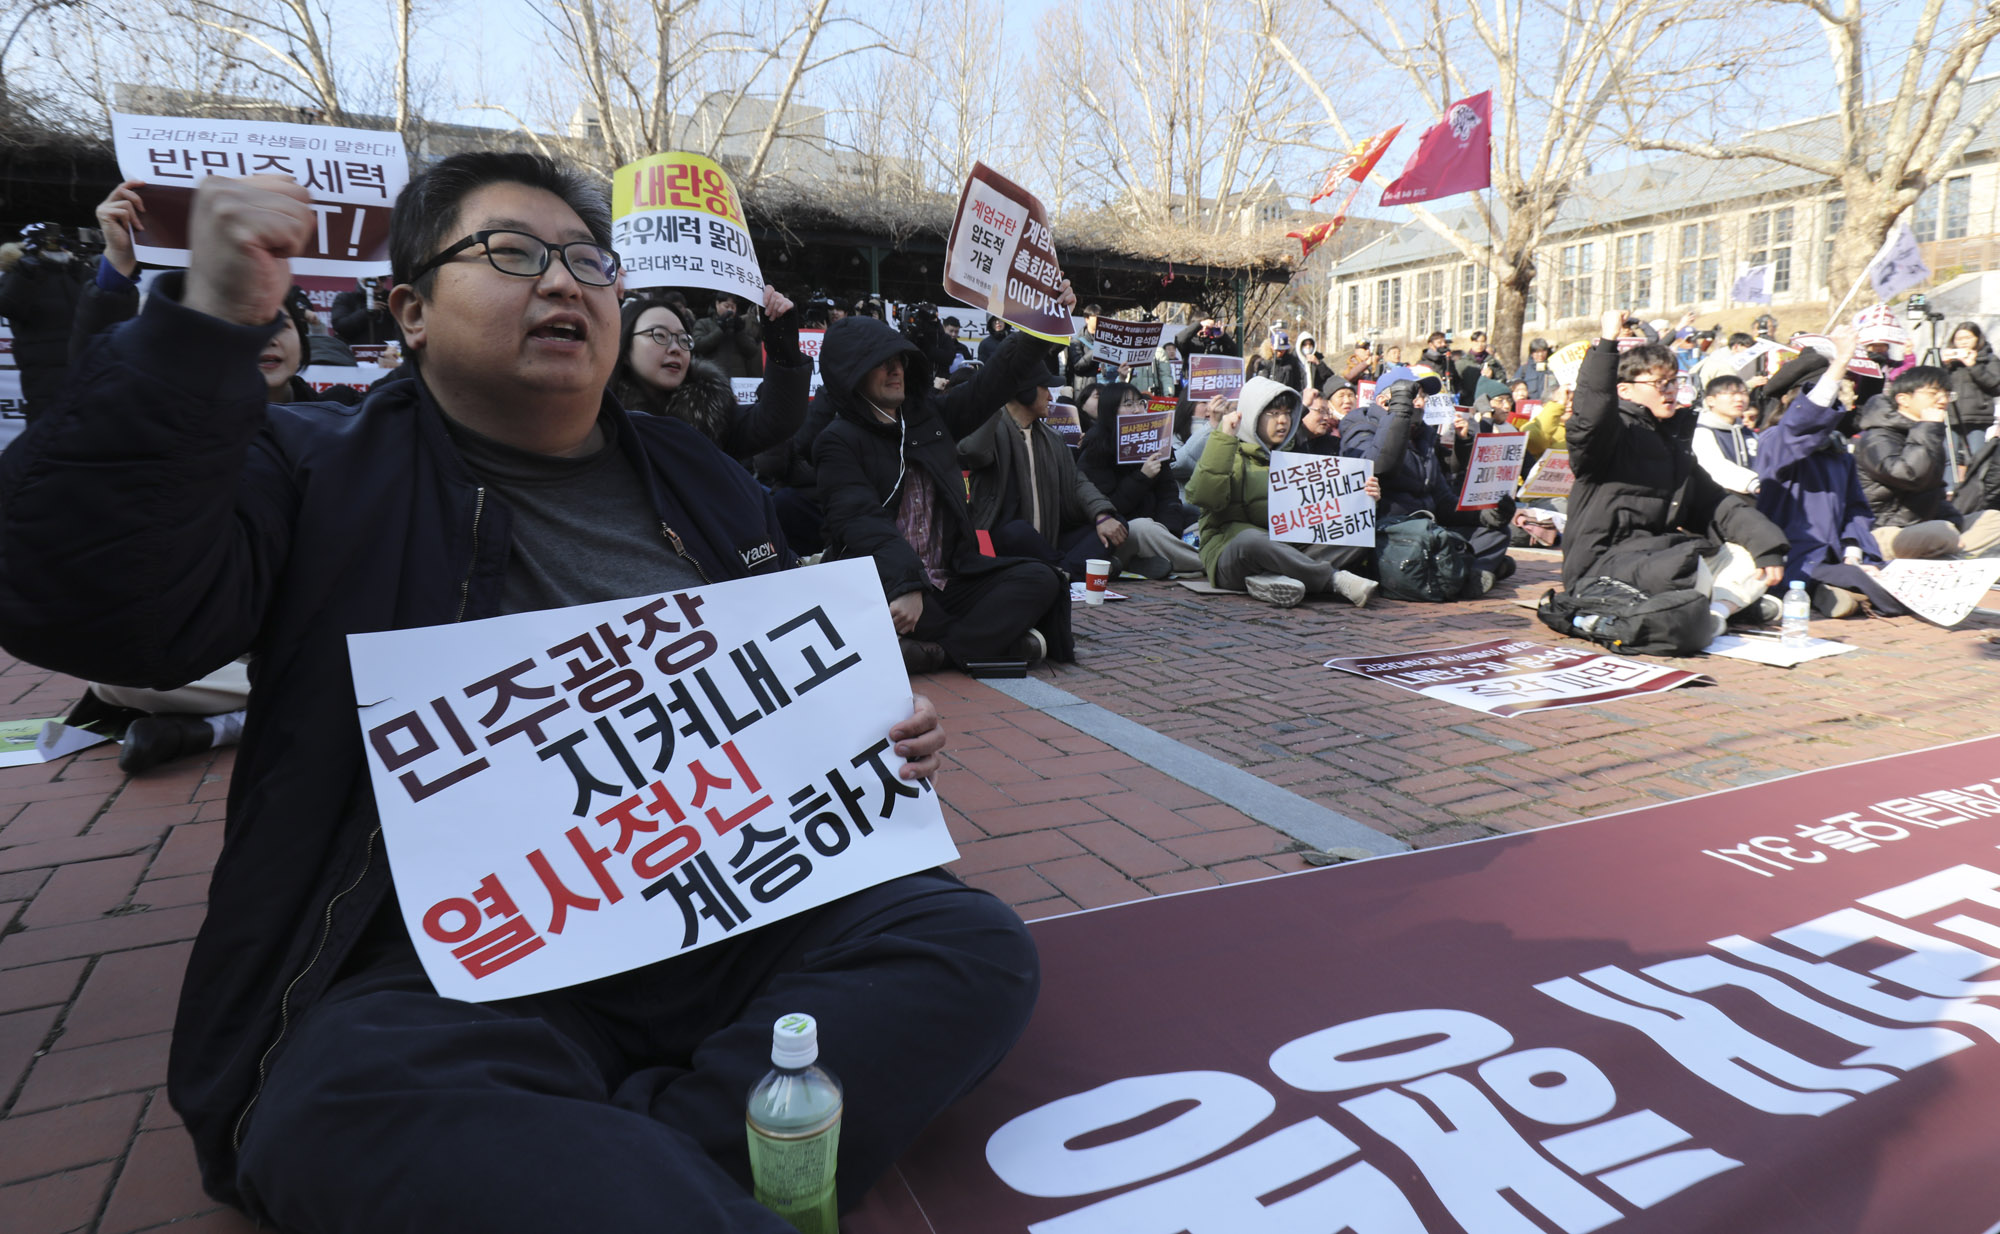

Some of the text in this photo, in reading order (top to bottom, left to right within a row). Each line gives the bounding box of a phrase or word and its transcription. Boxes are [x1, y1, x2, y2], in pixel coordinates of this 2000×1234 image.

[127, 127, 397, 158] 고려대학교 학생들이 말한다!
[614, 215, 702, 247] 극우세력
[971, 199, 1017, 237] 계엄규탄
[971, 224, 1006, 256] 압도적
[622, 254, 705, 273] 고려대학교
[970, 249, 994, 276] 가결
[1007, 277, 1066, 319] 이어가자
[1095, 329, 1160, 347] 내란수괴 윤석열
[1098, 344, 1153, 363] 즉각 파면!
[1190, 374, 1242, 391] 특검하라!
[1120, 429, 1158, 446] 민주주의
[1269, 457, 1341, 492] 민주광장
[1297, 470, 1367, 506] 지켜내고
[1270, 498, 1342, 536] 열사정신
[1308, 508, 1376, 543] 계승하자
[1383, 660, 1517, 685] 내란수괴
[1456, 678, 1564, 698] 즉각
[369, 592, 719, 804] 민주광장
[535, 604, 863, 819] 지켜내고
[640, 737, 933, 950] 계승하자
[1794, 812, 1911, 853] 오후
[421, 739, 774, 981] 열사정신
[1701, 835, 1828, 878] 3시
